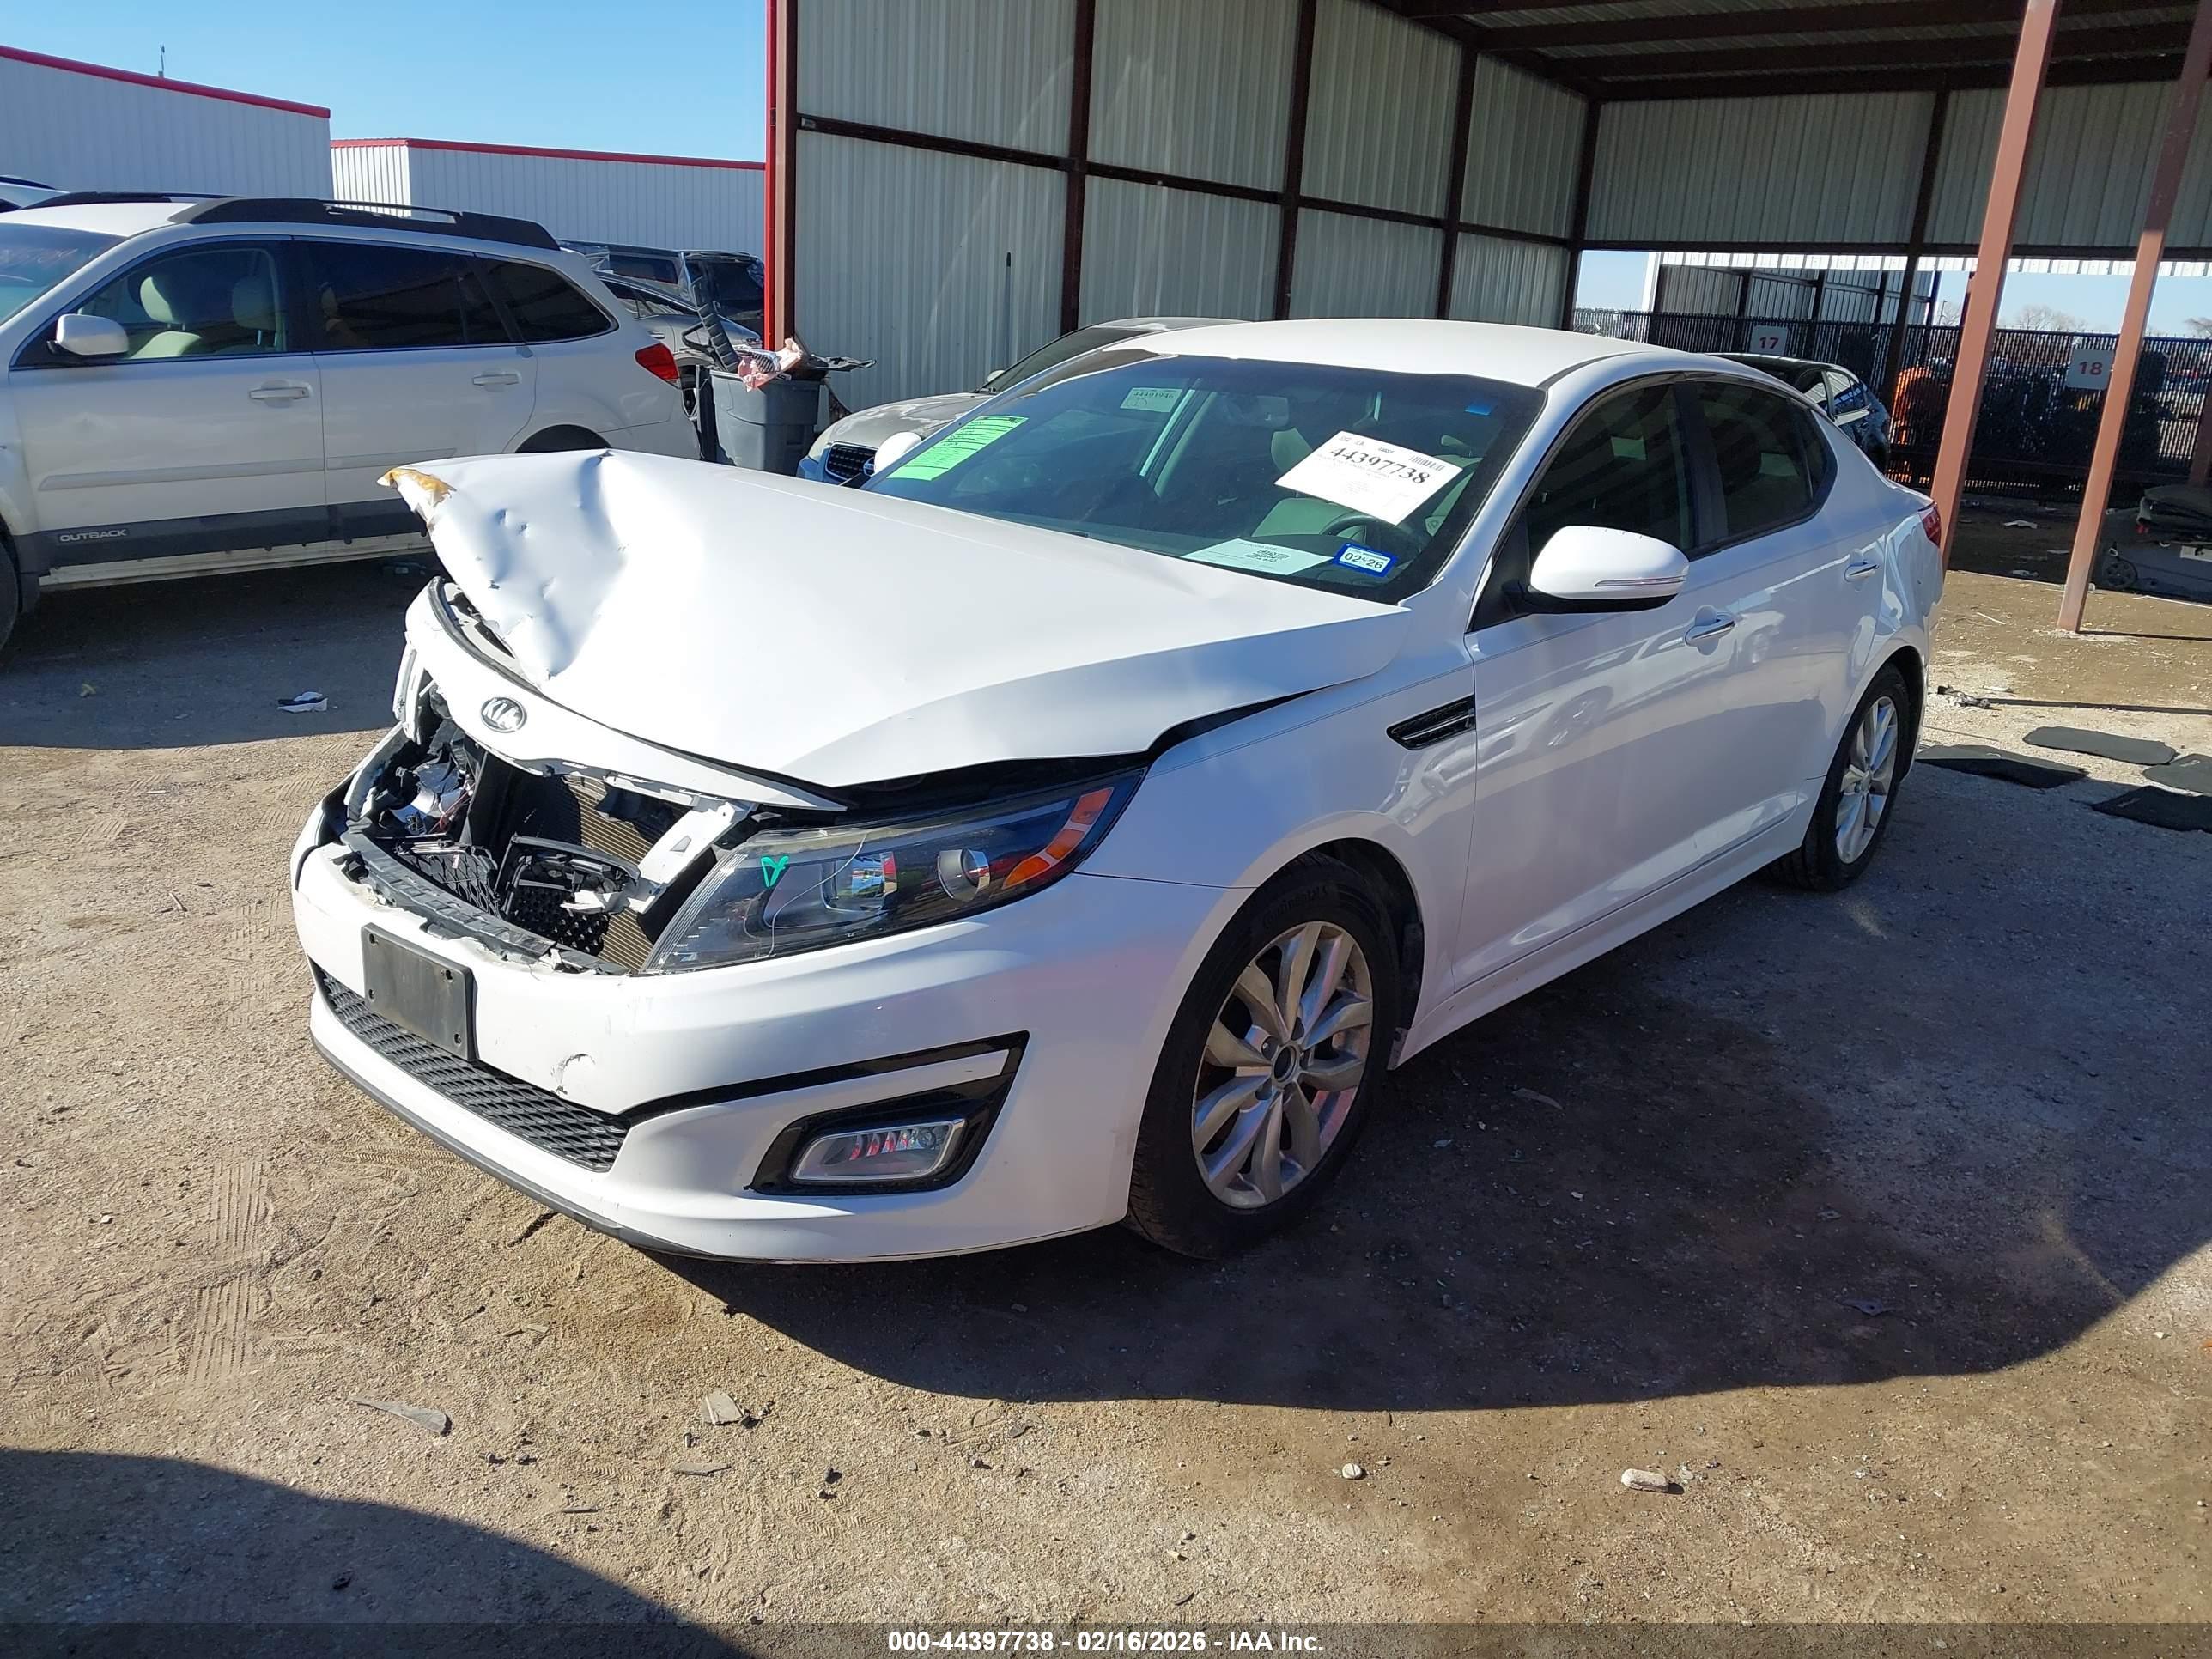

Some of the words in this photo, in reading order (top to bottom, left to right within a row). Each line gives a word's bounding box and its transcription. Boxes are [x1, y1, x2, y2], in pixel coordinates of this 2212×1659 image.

[1759, 336, 1780, 349] 17
[2079, 361, 2103, 376] 18
[1330, 447, 1431, 484] 44397738
[59, 528, 128, 542] OUTBACK
[1344, 552, 1362, 563] 02
[1365, 559, 1384, 569] 26
[481, 696, 522, 730] KIA
